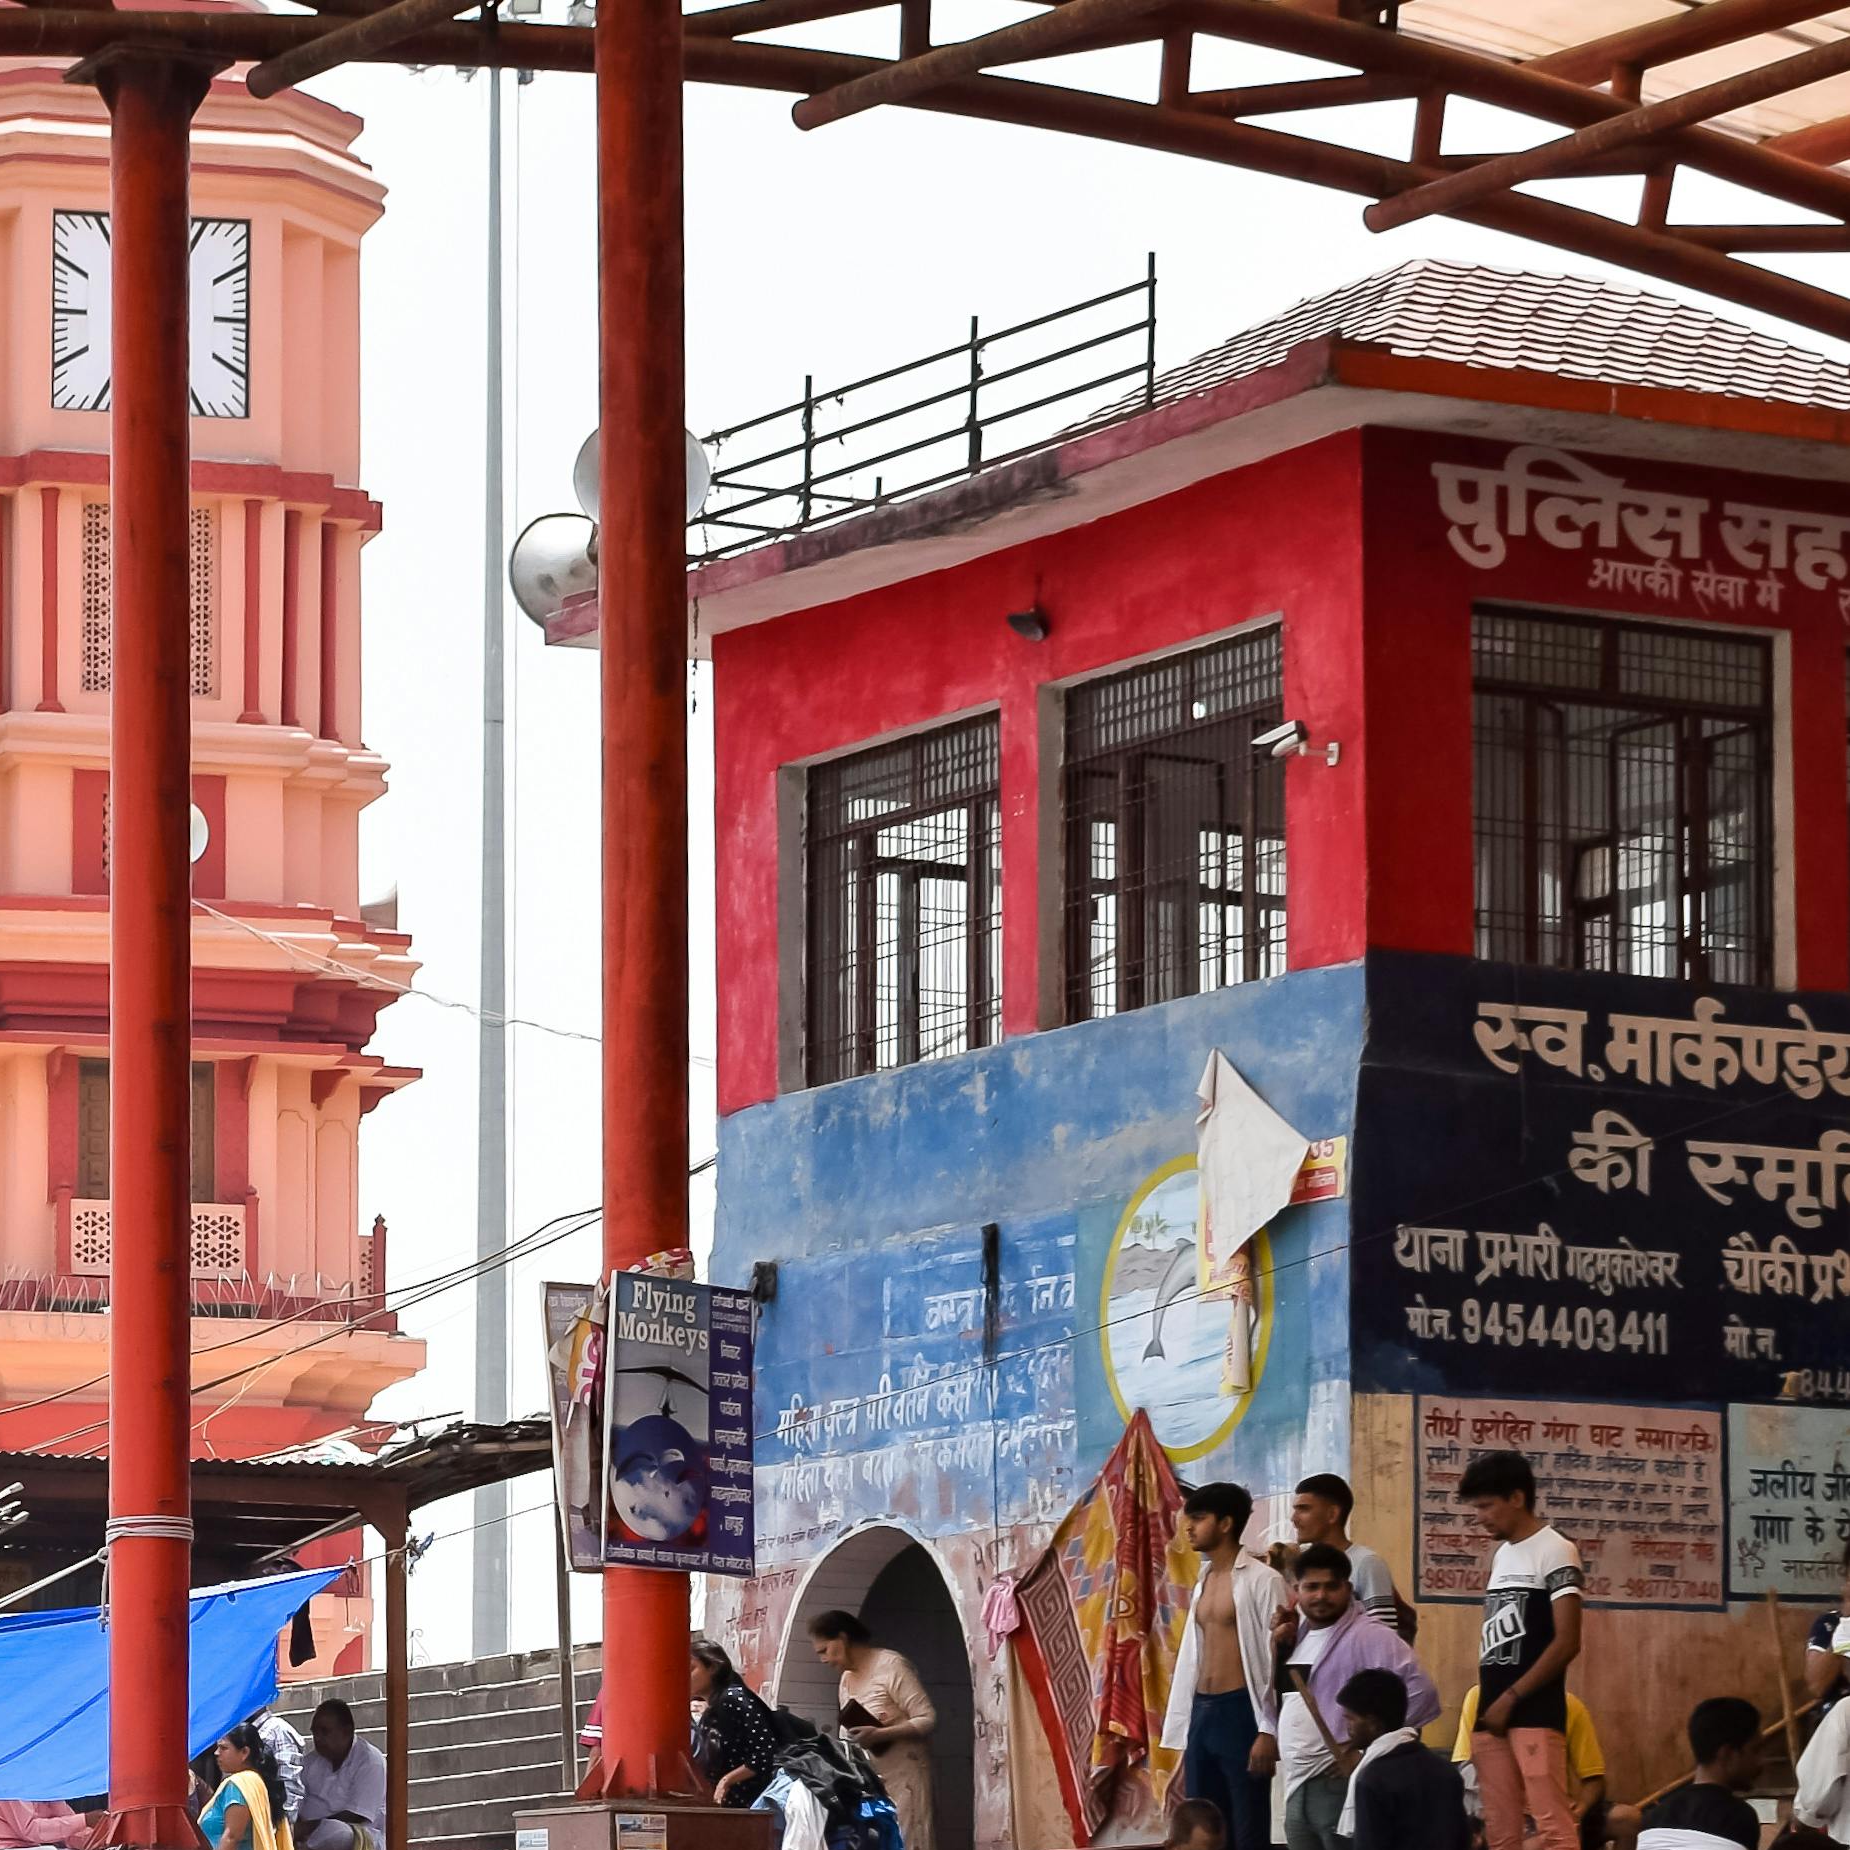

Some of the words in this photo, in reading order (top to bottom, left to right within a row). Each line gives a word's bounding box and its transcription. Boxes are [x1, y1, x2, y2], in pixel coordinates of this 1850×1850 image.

[1430, 445, 1710, 569] पुलिस
[1588, 558, 1681, 601] आपकी
[1692, 561, 1745, 614] सेवा
[1568, 1109, 1656, 1196] की
[1393, 1224, 1468, 1273] थाना
[1474, 1222, 1561, 1285] प्रभारी
[1721, 1231, 1806, 1295] चौकी
[632, 1281, 697, 1323] Flying
[1462, 1298, 1669, 1355] 9454403411
[618, 1312, 708, 1356] Monkeys
[1425, 1407, 1465, 1438] तीर्थ
[1471, 1410, 1535, 1445] पुरोहित
[1541, 1416, 1582, 1444] गंगा
[1589, 1425, 1624, 1448] घाट
[1749, 1460, 1816, 1500] जलीय
[1750, 1510, 1794, 1544] गंगा
[1805, 1506, 1825, 1546] के
